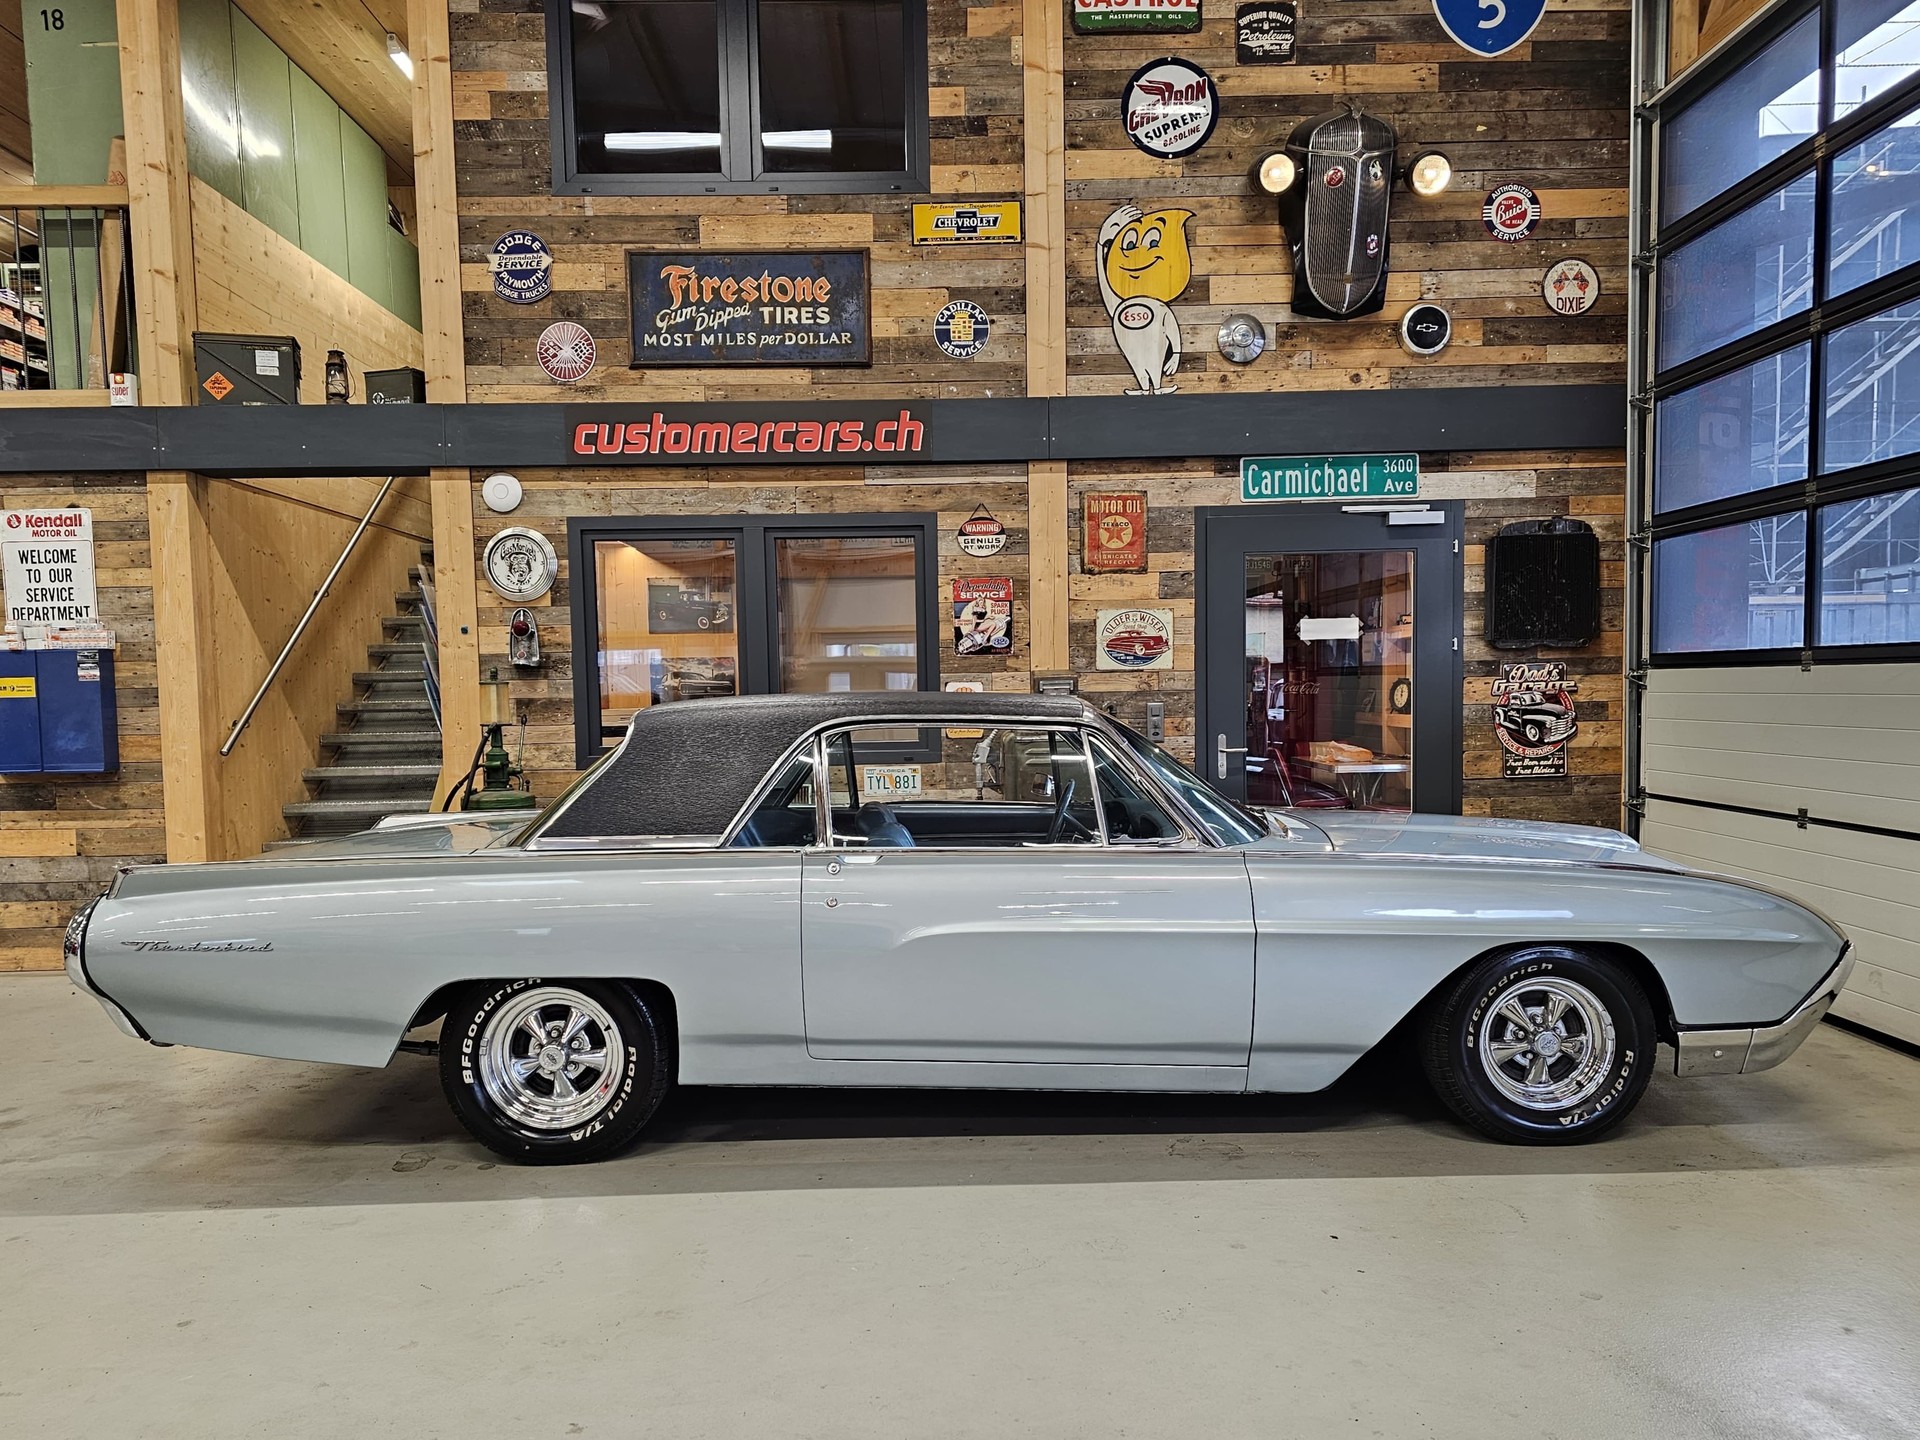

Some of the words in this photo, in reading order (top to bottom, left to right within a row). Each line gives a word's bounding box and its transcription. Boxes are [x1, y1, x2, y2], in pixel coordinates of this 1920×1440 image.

[40, 8, 64, 31] 18
[1238, 11, 1267, 26] SUPERIOR
[1268, 11, 1293, 25] QUALITY
[1477, 0, 1506, 29] 5
[1240, 29, 1292, 42] Petroleum
[1163, 124, 1200, 147] GASOLINE
[1491, 184, 1532, 200] AUTHORIZED
[1497, 199, 1529, 223] Buick
[937, 217, 995, 227] CHEVROLET
[1492, 228, 1530, 241] SERVICE
[497, 234, 542, 254] DODGE
[496, 260, 543, 269] SERVICE
[499, 270, 545, 289] PLYMOUTH
[660, 264, 832, 310] Firestone
[497, 284, 519, 299] DODGE
[521, 282, 548, 299] TRUCKS
[938, 302, 986, 323] CADILLAC
[1556, 296, 1586, 313] DIXIE
[694, 302, 752, 332] Dipped
[759, 306, 831, 324] TIRES
[644, 333, 694, 347] MOST
[700, 332, 757, 346] MILES
[759, 334, 783, 348] per
[784, 332, 853, 345] DOLLAR
[942, 340, 982, 357] SERVICE
[573, 409, 924, 454] customercars.ch
[1383, 458, 1413, 473] 3600
[1247, 461, 1368, 495] Carmichael
[1384, 478, 1414, 493] Ave
[1090, 500, 1123, 514] MOTOR
[1126, 500, 1142, 513] OIL
[25, 513, 83, 528] Kendall
[965, 523, 999, 533] WARNING
[32, 529, 62, 537] MOTOR
[64, 529, 77, 537] OIL
[963, 537, 1001, 545] GENIUS
[18, 548, 77, 564] WELCOME
[26, 568, 41, 583] TO
[49, 567, 73, 583] OUR
[959, 580, 1008, 592] Dependable
[26, 587, 75, 603] SERVICE
[960, 591, 1006, 599] SERVICE
[12, 605, 90, 621] DEPARTMENT
[1105, 613, 1131, 635] OLDER
[1139, 613, 1164, 633] WISER
[1509, 663, 1560, 683] Dad's
[1492, 680, 1578, 696] Garage
[1497, 727, 1519, 752] SERVICE
[1524, 744, 1555, 756] REPAIRS
[867, 775, 890, 790] TYL
[120, 939, 274, 952] Thunderbird
[1467, 962, 1553, 1049] BFGoodrich
[461, 976, 542, 1085] BFGoodrich
[608, 1045, 637, 1121] Radial
[1594, 1049, 1635, 1112] Radial
[1558, 1109, 1592, 1126] T/A
[570, 1120, 604, 1142] T/A
